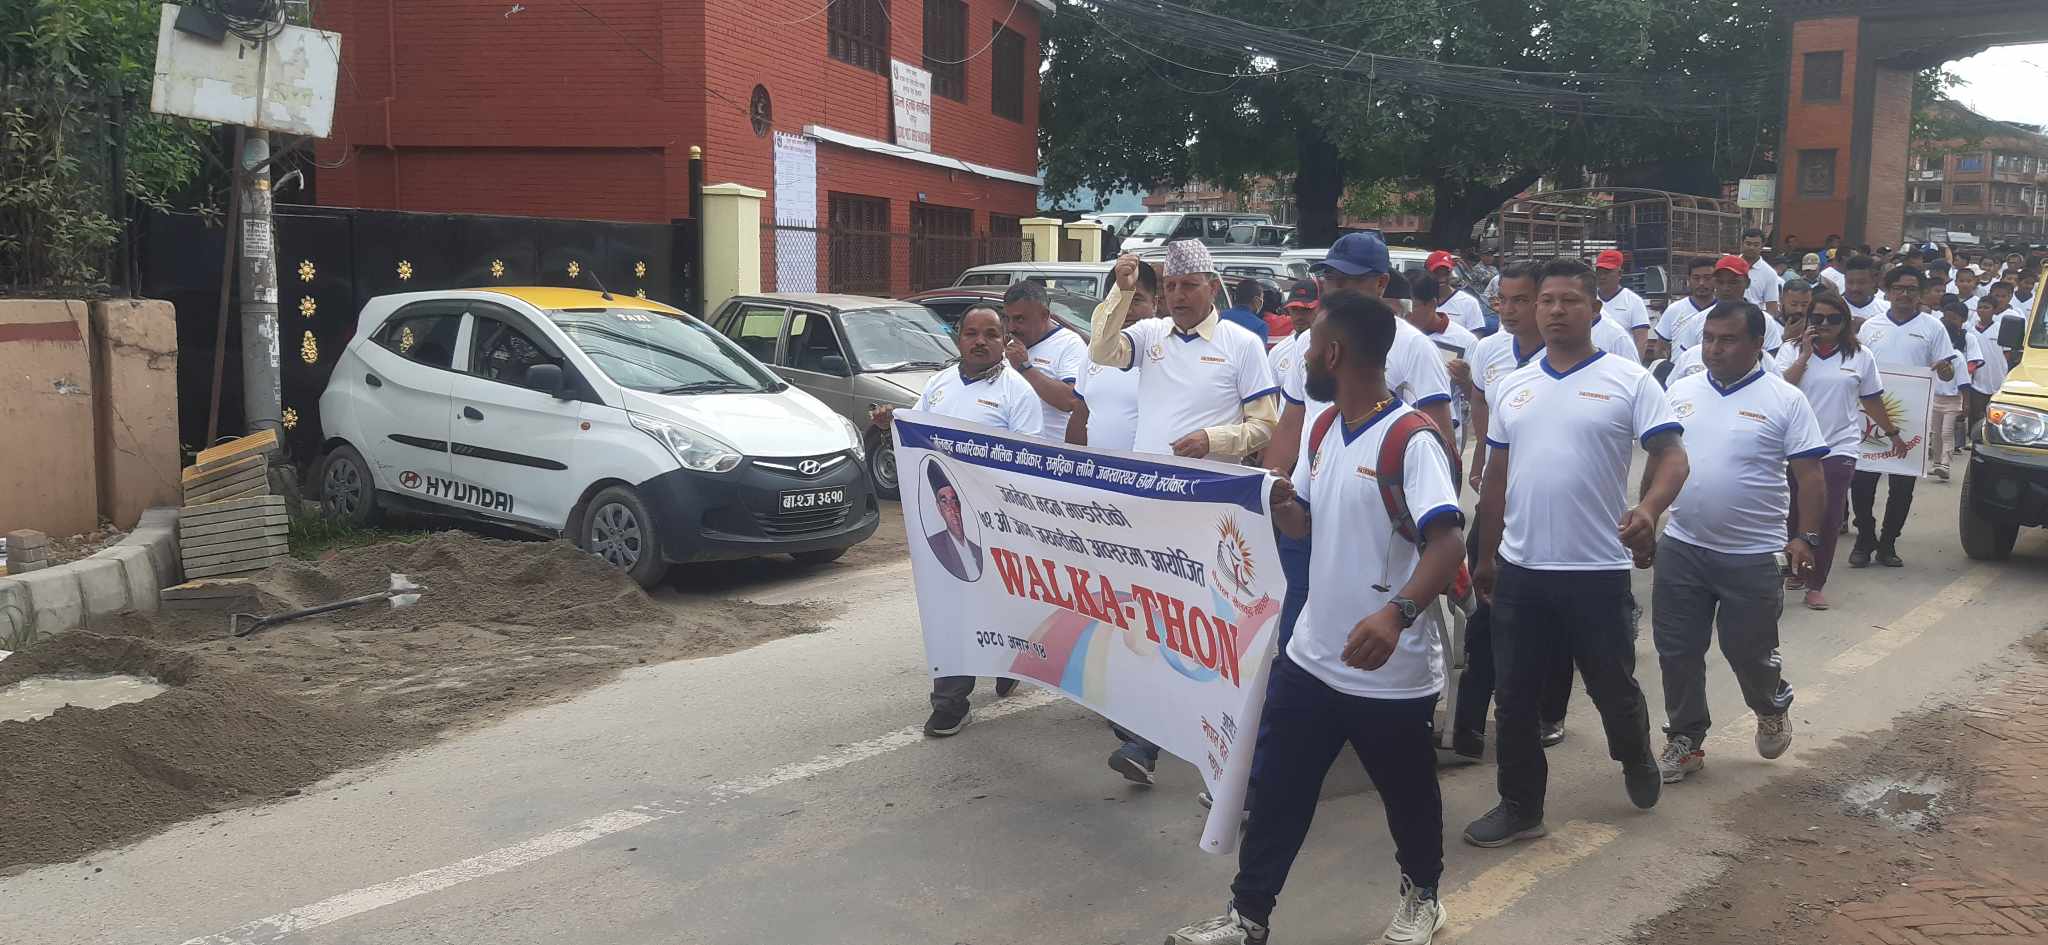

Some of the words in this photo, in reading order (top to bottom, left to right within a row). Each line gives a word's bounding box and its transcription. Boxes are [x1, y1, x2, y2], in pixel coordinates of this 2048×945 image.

[426, 475, 514, 513] HYUNDAI
[817, 490, 843, 506] ३६१०
[1031, 494, 1067, 519] मदन
[1061, 500, 1133, 529] भण्डारीको
[1086, 538, 1148, 568] अवसरमा
[1144, 546, 1206, 588] आयोजित
[989, 546, 1240, 689] WALKA-THON
[976, 630, 1005, 648] २०८०
